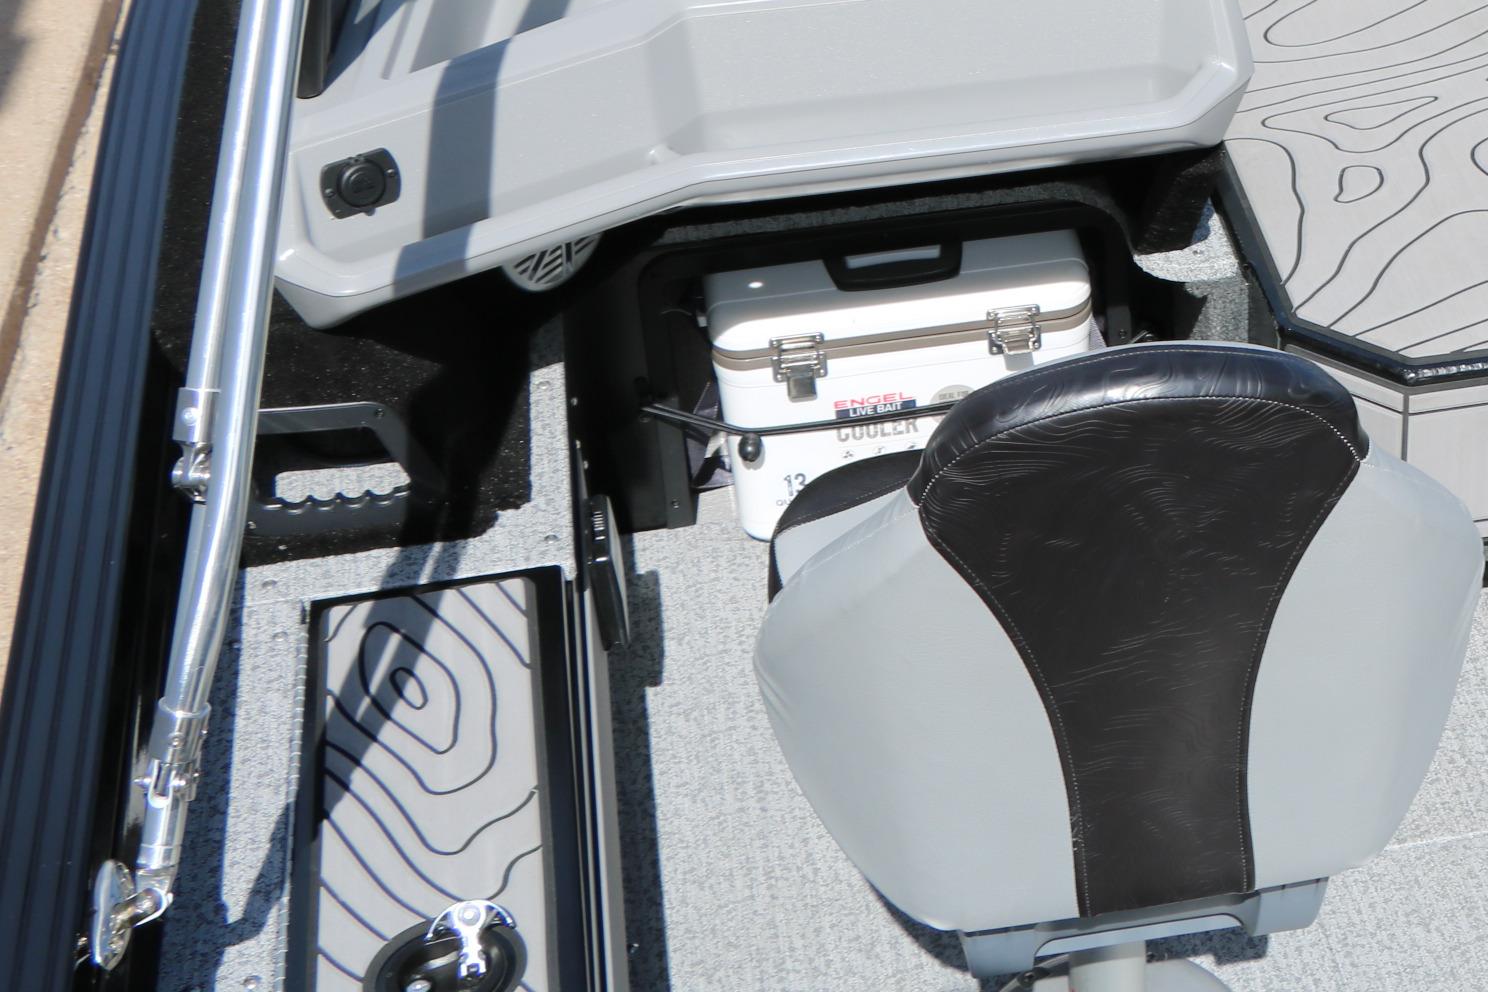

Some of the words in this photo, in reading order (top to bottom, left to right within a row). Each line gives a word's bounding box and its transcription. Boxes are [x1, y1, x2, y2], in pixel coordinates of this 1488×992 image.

[834, 392, 913, 409] ENGEL
[850, 405, 874, 417] LIVE
[877, 401, 902, 413] BAIT
[784, 473, 806, 496] 13
